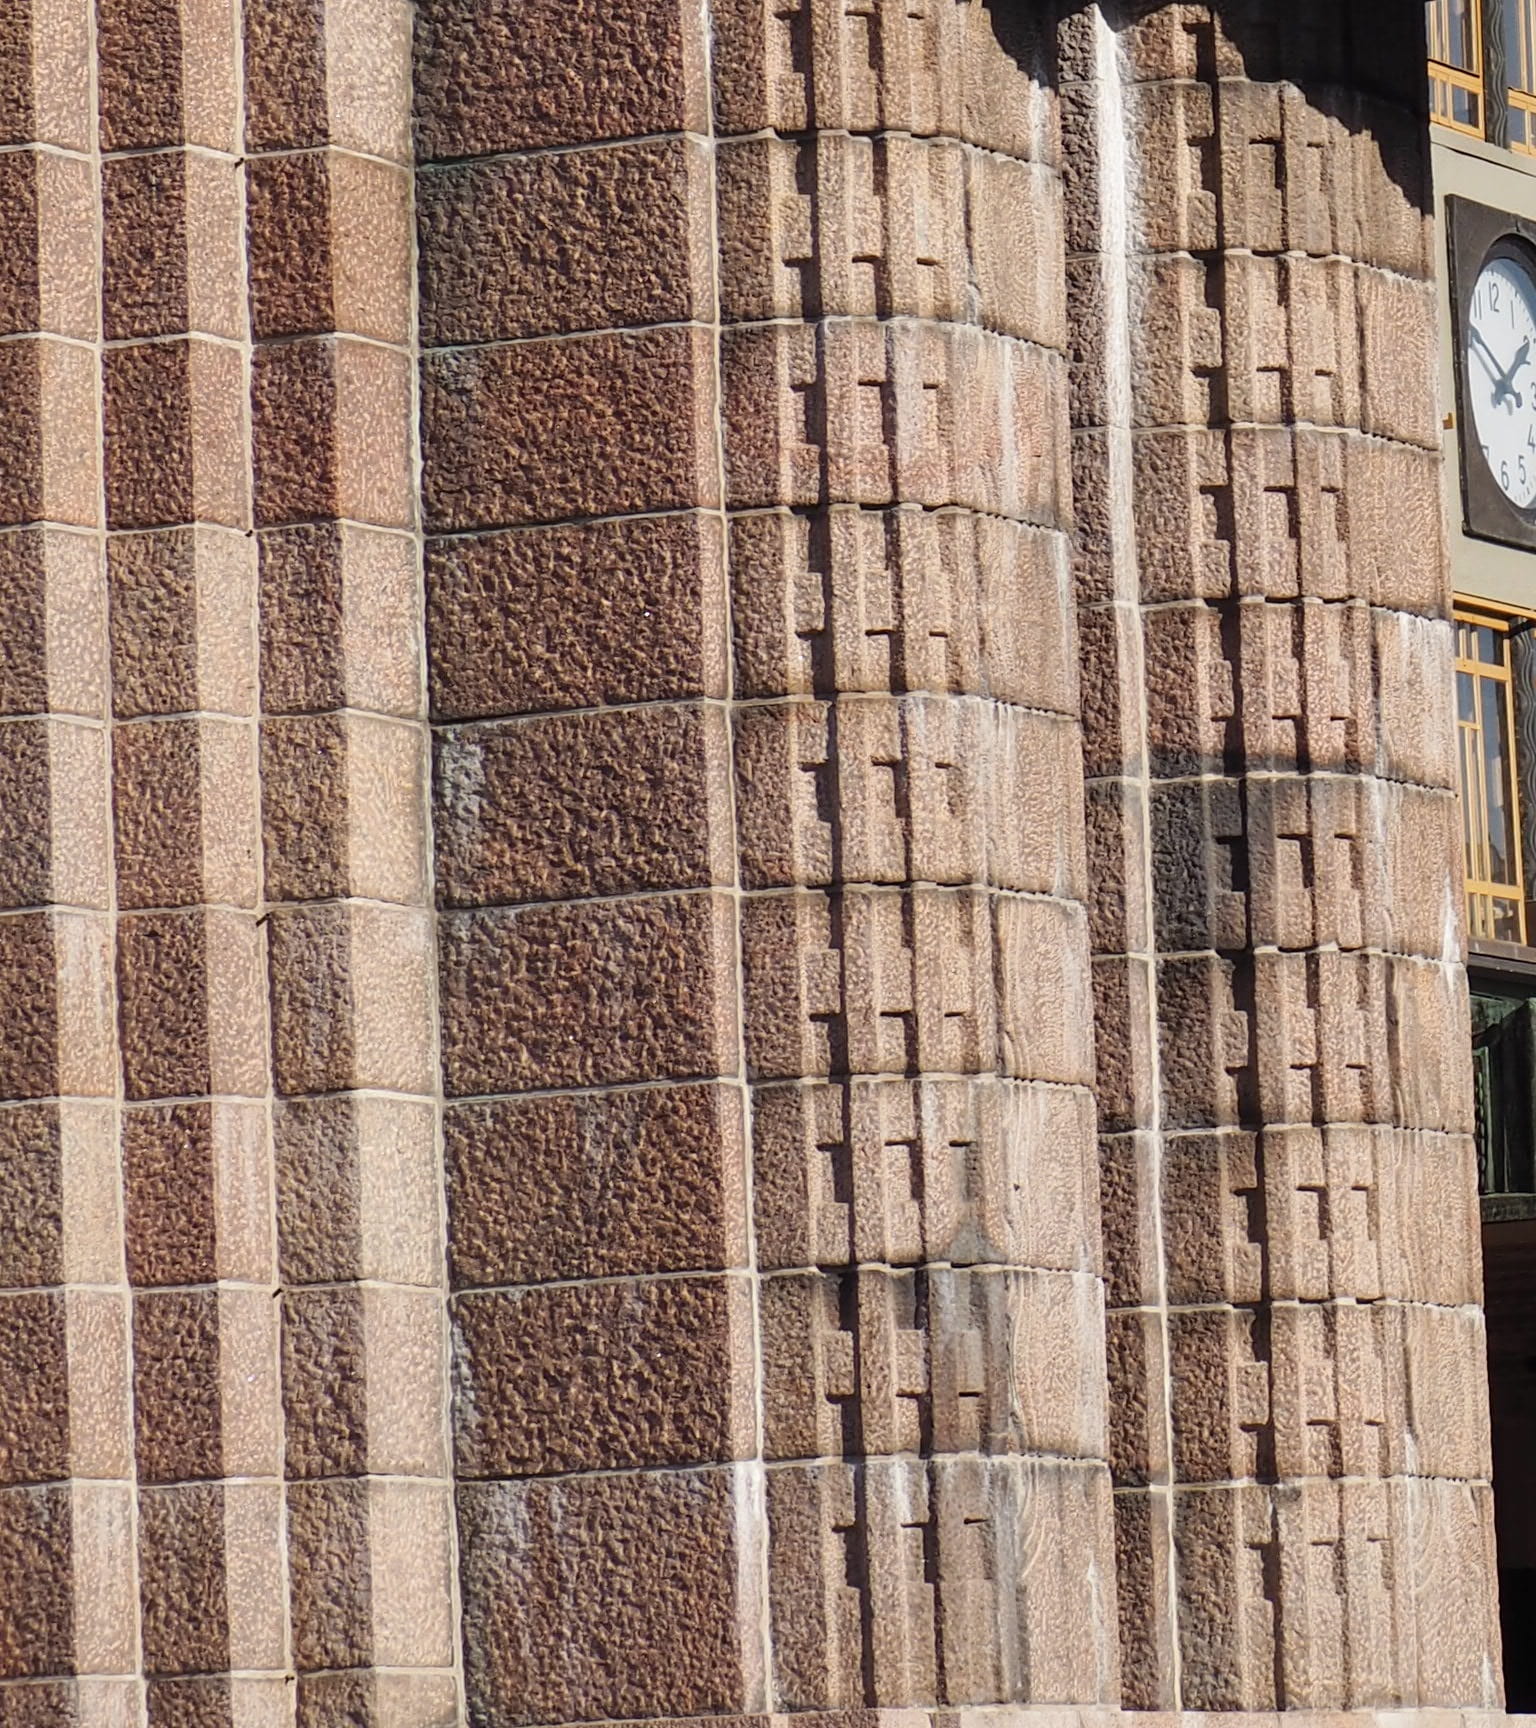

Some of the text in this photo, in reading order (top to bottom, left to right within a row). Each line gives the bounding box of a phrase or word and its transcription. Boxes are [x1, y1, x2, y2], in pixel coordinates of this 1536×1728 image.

[1488, 281, 1500, 313] 12
[1527, 424, 1536, 454] 4
[1500, 460, 1510, 491] 6
[1518, 454, 1527, 485] 5
